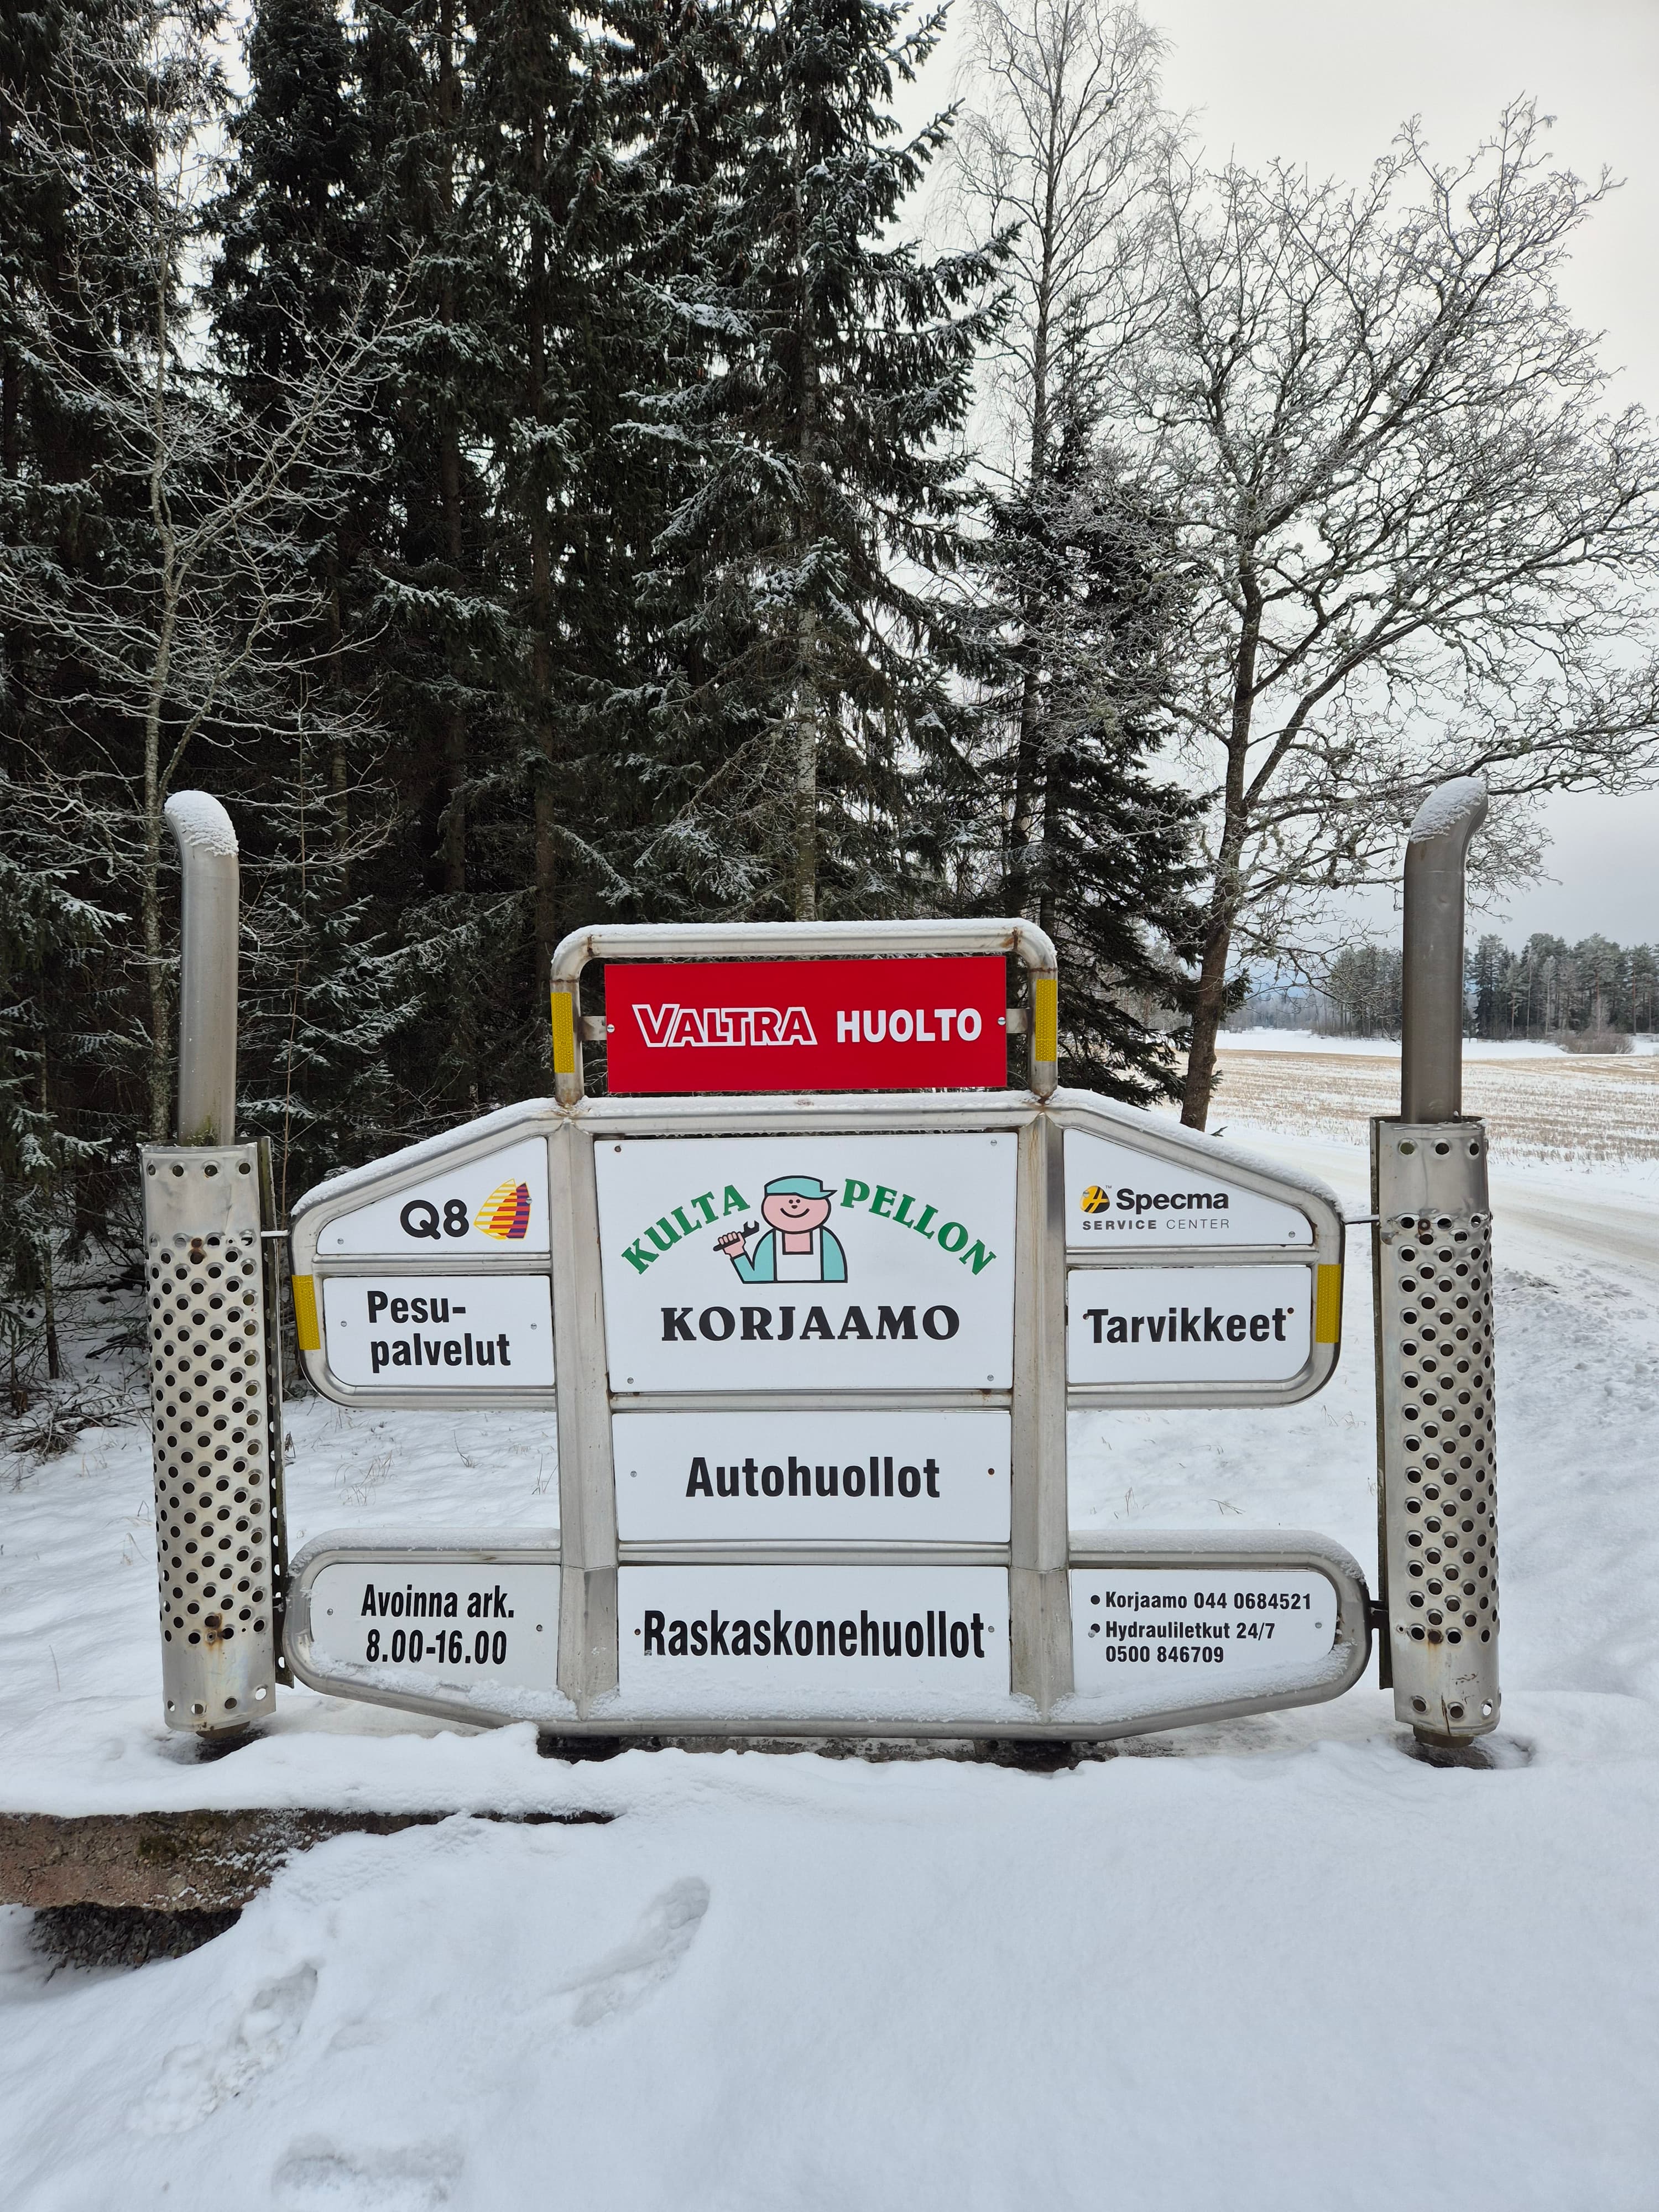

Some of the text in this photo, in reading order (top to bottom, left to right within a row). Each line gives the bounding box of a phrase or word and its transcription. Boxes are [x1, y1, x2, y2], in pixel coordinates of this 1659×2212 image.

[632, 1004, 982, 1047] VALTRA HUOLTO
[400, 1199, 469, 1240] Q8
[1116, 1188, 1229, 1215] Specma
[621, 1178, 997, 1275] KULTA PELLON
[1082, 1218, 1229, 1230] SERVICE CENTER
[367, 1291, 466, 1323] Pesu-
[661, 1305, 960, 1342] KORJAAMO
[1087, 1307, 1286, 1344] Tarvikkeet
[371, 1333, 511, 1374] palvelut
[686, 1456, 940, 1498] Autohuollot
[361, 1584, 514, 1618] Avoinna ark.
[1105, 1591, 1311, 1611] Korjaamo 044 0684521
[366, 1629, 507, 1665] 8.00-16.00
[644, 1610, 985, 1658] Raskaskonehuollot
[1105, 1621, 1275, 1641] Hydrauliletkut 24/7
[1105, 1645, 1224, 1663] 0500 846709
